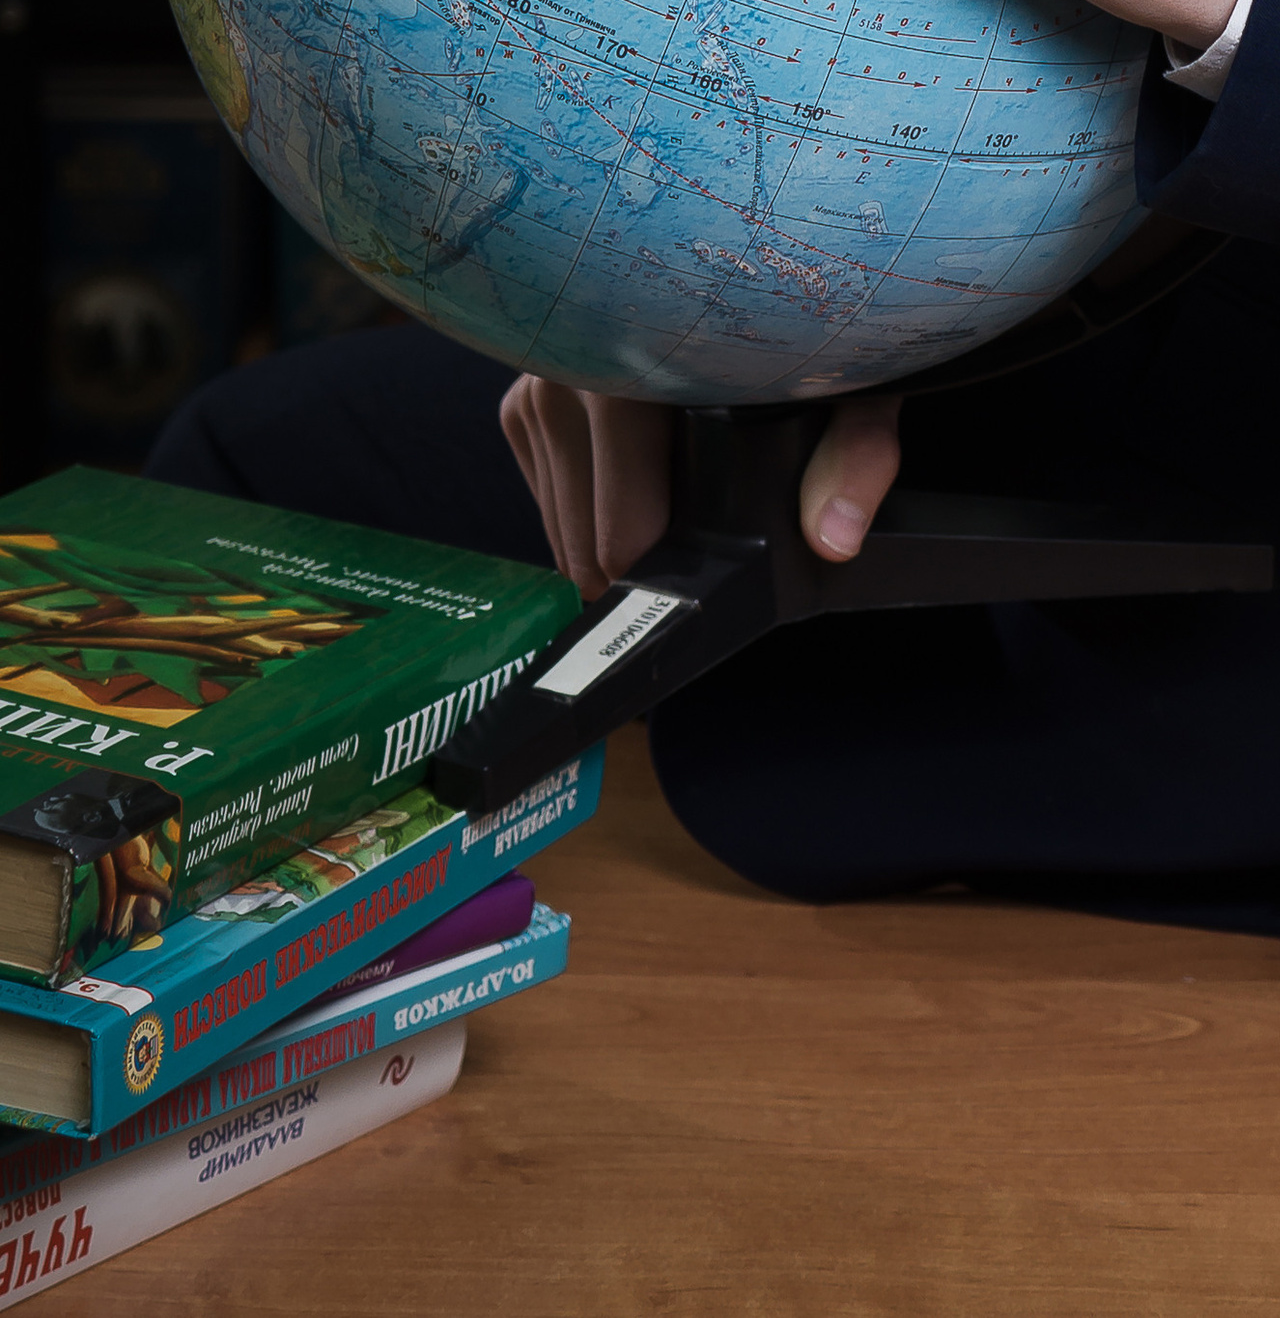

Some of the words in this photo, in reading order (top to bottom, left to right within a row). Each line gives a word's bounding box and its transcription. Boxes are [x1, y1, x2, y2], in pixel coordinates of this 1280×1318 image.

[564, 7, 576, 18] от
[576, 11, 617, 36] Гринвича
[858, 19, 882, 32] 5158
[596, 35, 637, 60] 170°
[463, 85, 496, 107] 10°
[689, 71, 729, 93] 160°
[475, 47, 593, 81] ЮЖНОЕ
[691, 110, 896, 169] ПАССАТНОЕ
[792, 102, 832, 122] 150°
[890, 123, 929, 141] 140°
[984, 134, 1019, 149] 130°
[1068, 131, 1097, 146] 120°
[436, 162, 467, 182] 20°
[144, 741, 215, 776] Р.
[320, 732, 360, 767] Свет
[268, 750, 319, 792] погас.
[187, 785, 262, 842] Рассказы
[263, 782, 313, 820] Книги
[184, 806, 262, 877] джунглей
[274, 844, 454, 977] ДОИСТОРИЧЕСКИЕ
[171, 960, 268, 1054] ПОВЕСТИ
[392, 958, 536, 1034] Ю.ДРУЖКОВ
[281, 1011, 377, 1080] ВОЛШЕБНАЯ
[217, 1050, 277, 1099] ШКОЛА
[108, 1075, 212, 1154] КАРАНДАША
[187, 1081, 320, 1160] ЖЕЛЕЗНИКОВ
[197, 1116, 305, 1183] ВЛАДИМИР
